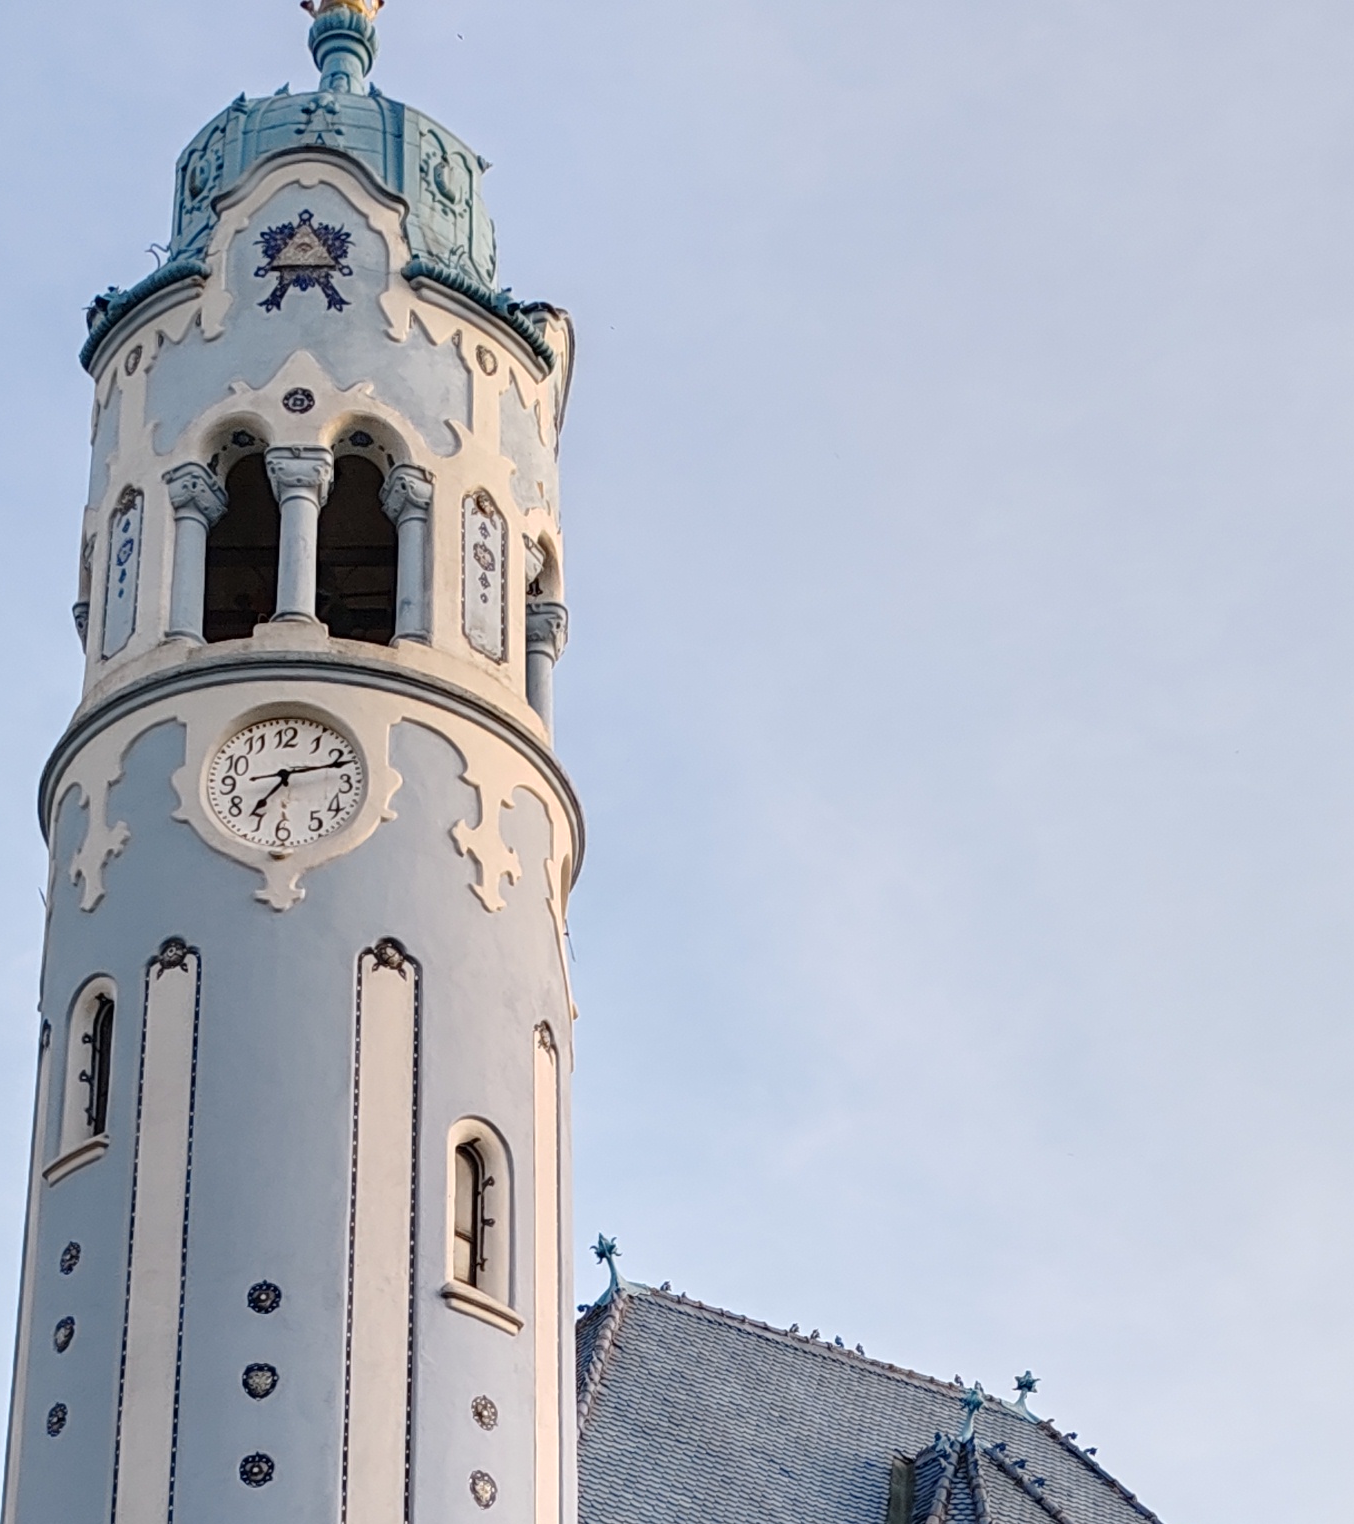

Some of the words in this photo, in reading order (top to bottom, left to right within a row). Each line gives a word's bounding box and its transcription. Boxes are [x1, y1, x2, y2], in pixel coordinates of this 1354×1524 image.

[244, 733, 266, 755] 11
[274, 727, 298, 749] 12
[309, 734, 323, 755] 1
[225, 754, 249, 776] 10
[328, 748, 345, 768] 2
[219, 775, 237, 796] 9
[339, 773, 353, 794] 3
[228, 795, 243, 818] 8
[327, 792, 346, 820] 4
[250, 811, 268, 833] 7
[275, 818, 291, 842] 6
[308, 810, 323, 832] 5
